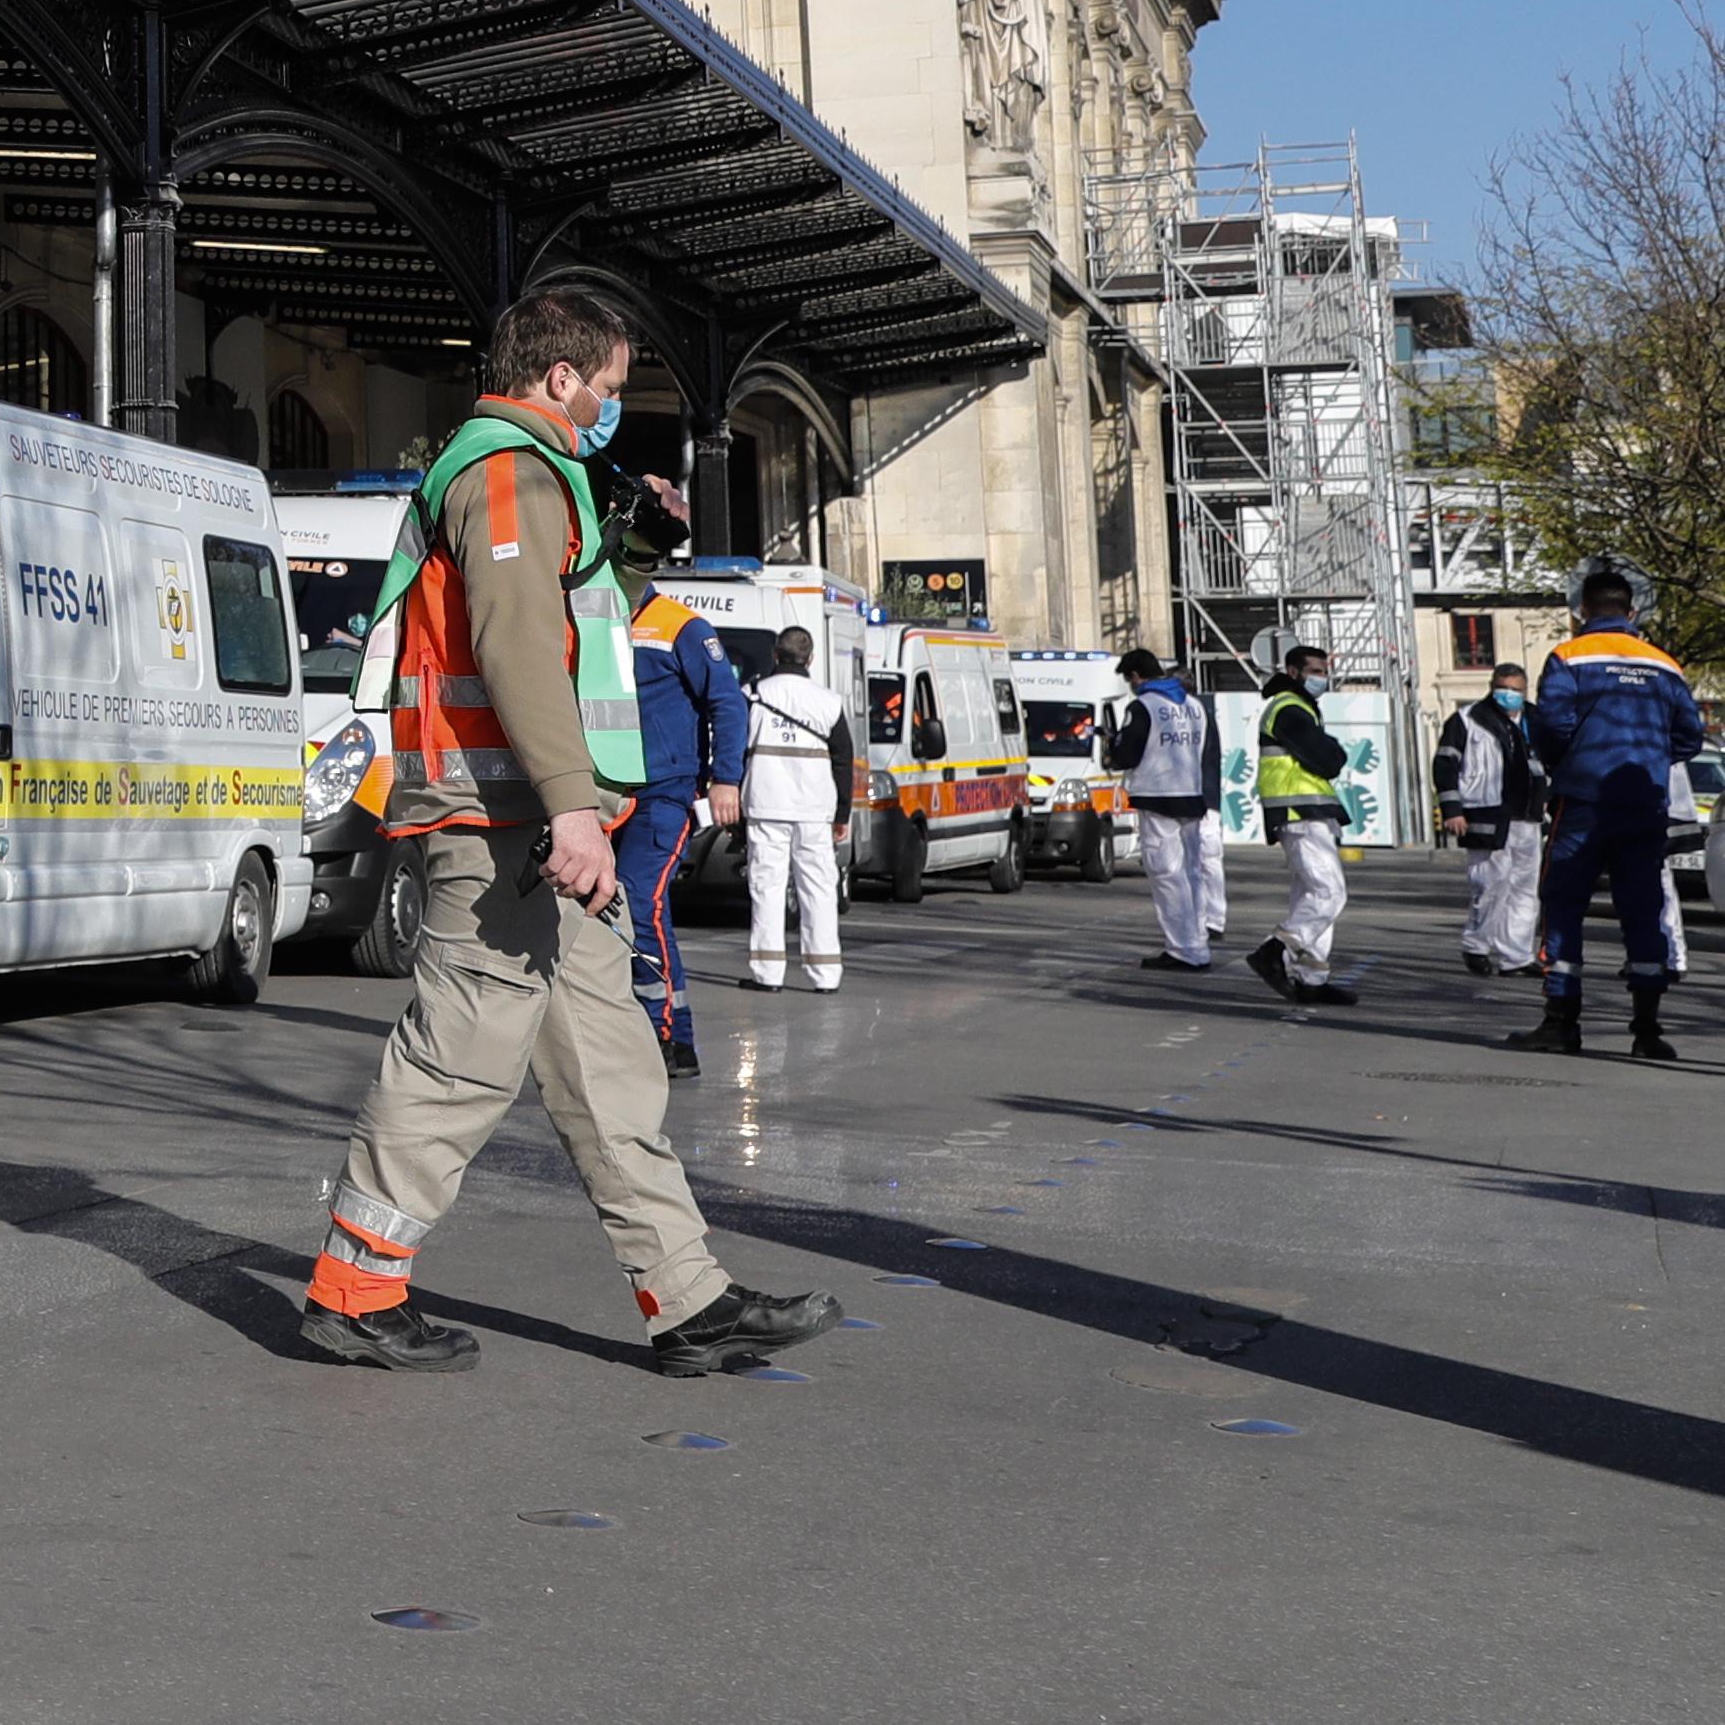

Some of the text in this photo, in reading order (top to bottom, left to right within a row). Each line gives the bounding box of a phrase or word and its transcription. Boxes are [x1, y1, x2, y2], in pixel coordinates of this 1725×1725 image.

[9, 433, 254, 513] SAUVETEURS SECOURISTES DE SOLOGNE
[290, 530, 332, 541] CIVILE
[950, 576, 961, 585] 10
[19, 562, 81, 623] FFSS
[85, 573, 108, 627] 41
[683, 594, 735, 612] CIVILE
[11, 689, 299, 734] VEHICULE DE PREMIERS SECOURS A PERSONNES
[1158, 704, 1202, 721] SAMU
[782, 732, 796, 743] 91
[1160, 731, 1201, 747] PARIS
[10, 762, 88, 814] Française
[94, 772, 112, 805] de
[118, 766, 189, 813] Sauvetage
[196, 776, 209, 805] et
[210, 774, 227, 805] de
[231, 770, 303, 807] Secourisme
